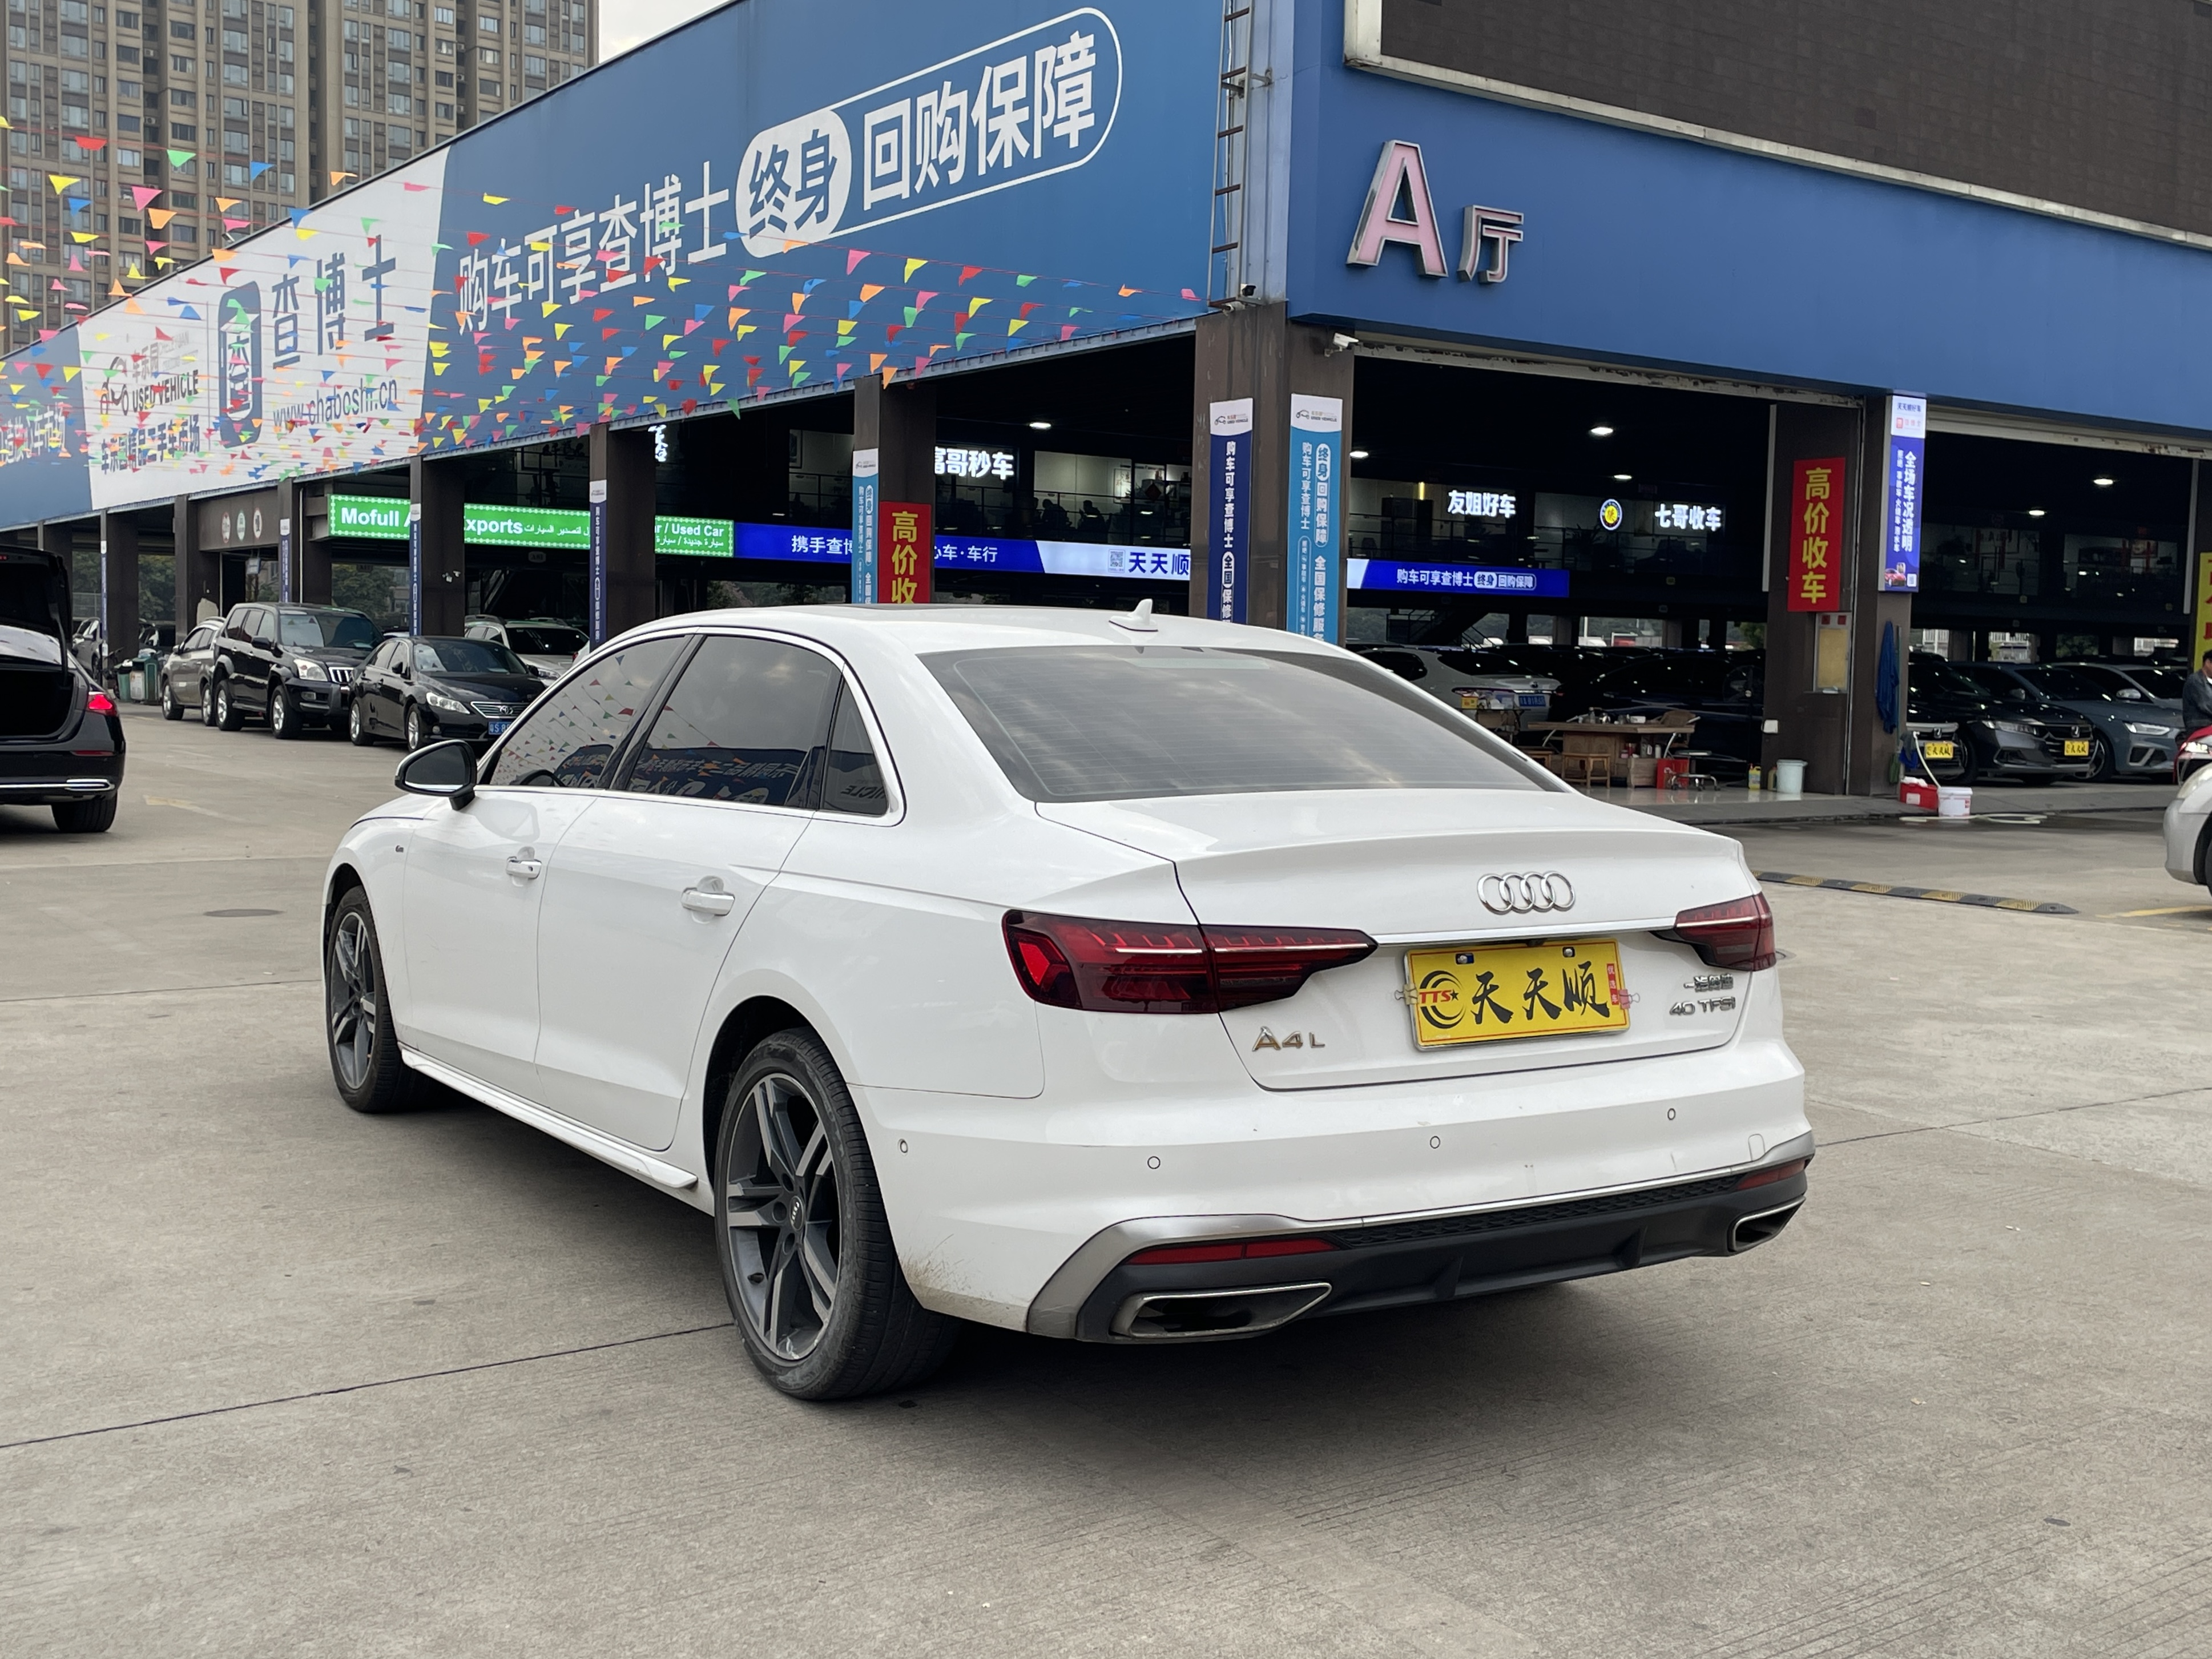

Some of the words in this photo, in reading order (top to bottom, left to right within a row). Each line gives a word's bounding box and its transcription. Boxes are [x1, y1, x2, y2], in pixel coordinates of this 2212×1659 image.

[458, 160, 729, 335] 购车可享查博士
[748, 128, 839, 239] 终身
[863, 31, 1097, 211] 回购保障
[272, 235, 396, 370] 查博士
[1317, 447, 1328, 478] 终身
[1224, 441, 1236, 548] 购车可享查博士
[1300, 442, 1312, 530] 购车可享查博士
[1315, 482, 1328, 543] 回购保障
[1447, 489, 1516, 519] 友姐好车
[1654, 503, 1722, 531] 七哥收车
[1902, 451, 1917, 553] 全场车况透明
[341, 507, 400, 528] Mofull
[464, 519, 523, 536] xports
[671, 523, 701, 536] Used
[704, 525, 724, 537] Car
[1800, 467, 1832, 605] 高价收车
[1128, 551, 1190, 576] 天天顺
[1224, 554, 1233, 583] 全国
[1396, 569, 1473, 587] 购车可享查博士
[1477, 573, 1494, 587] 终身
[1498, 576, 1534, 589] 回购保障
[1222, 589, 1232, 622] 保修
[1419, 990, 1451, 1004] TTS
[1471, 961, 1611, 1025] 天天顺
[1669, 1001, 1695, 1016] 40
[1698, 996, 1736, 1013] TFSI
